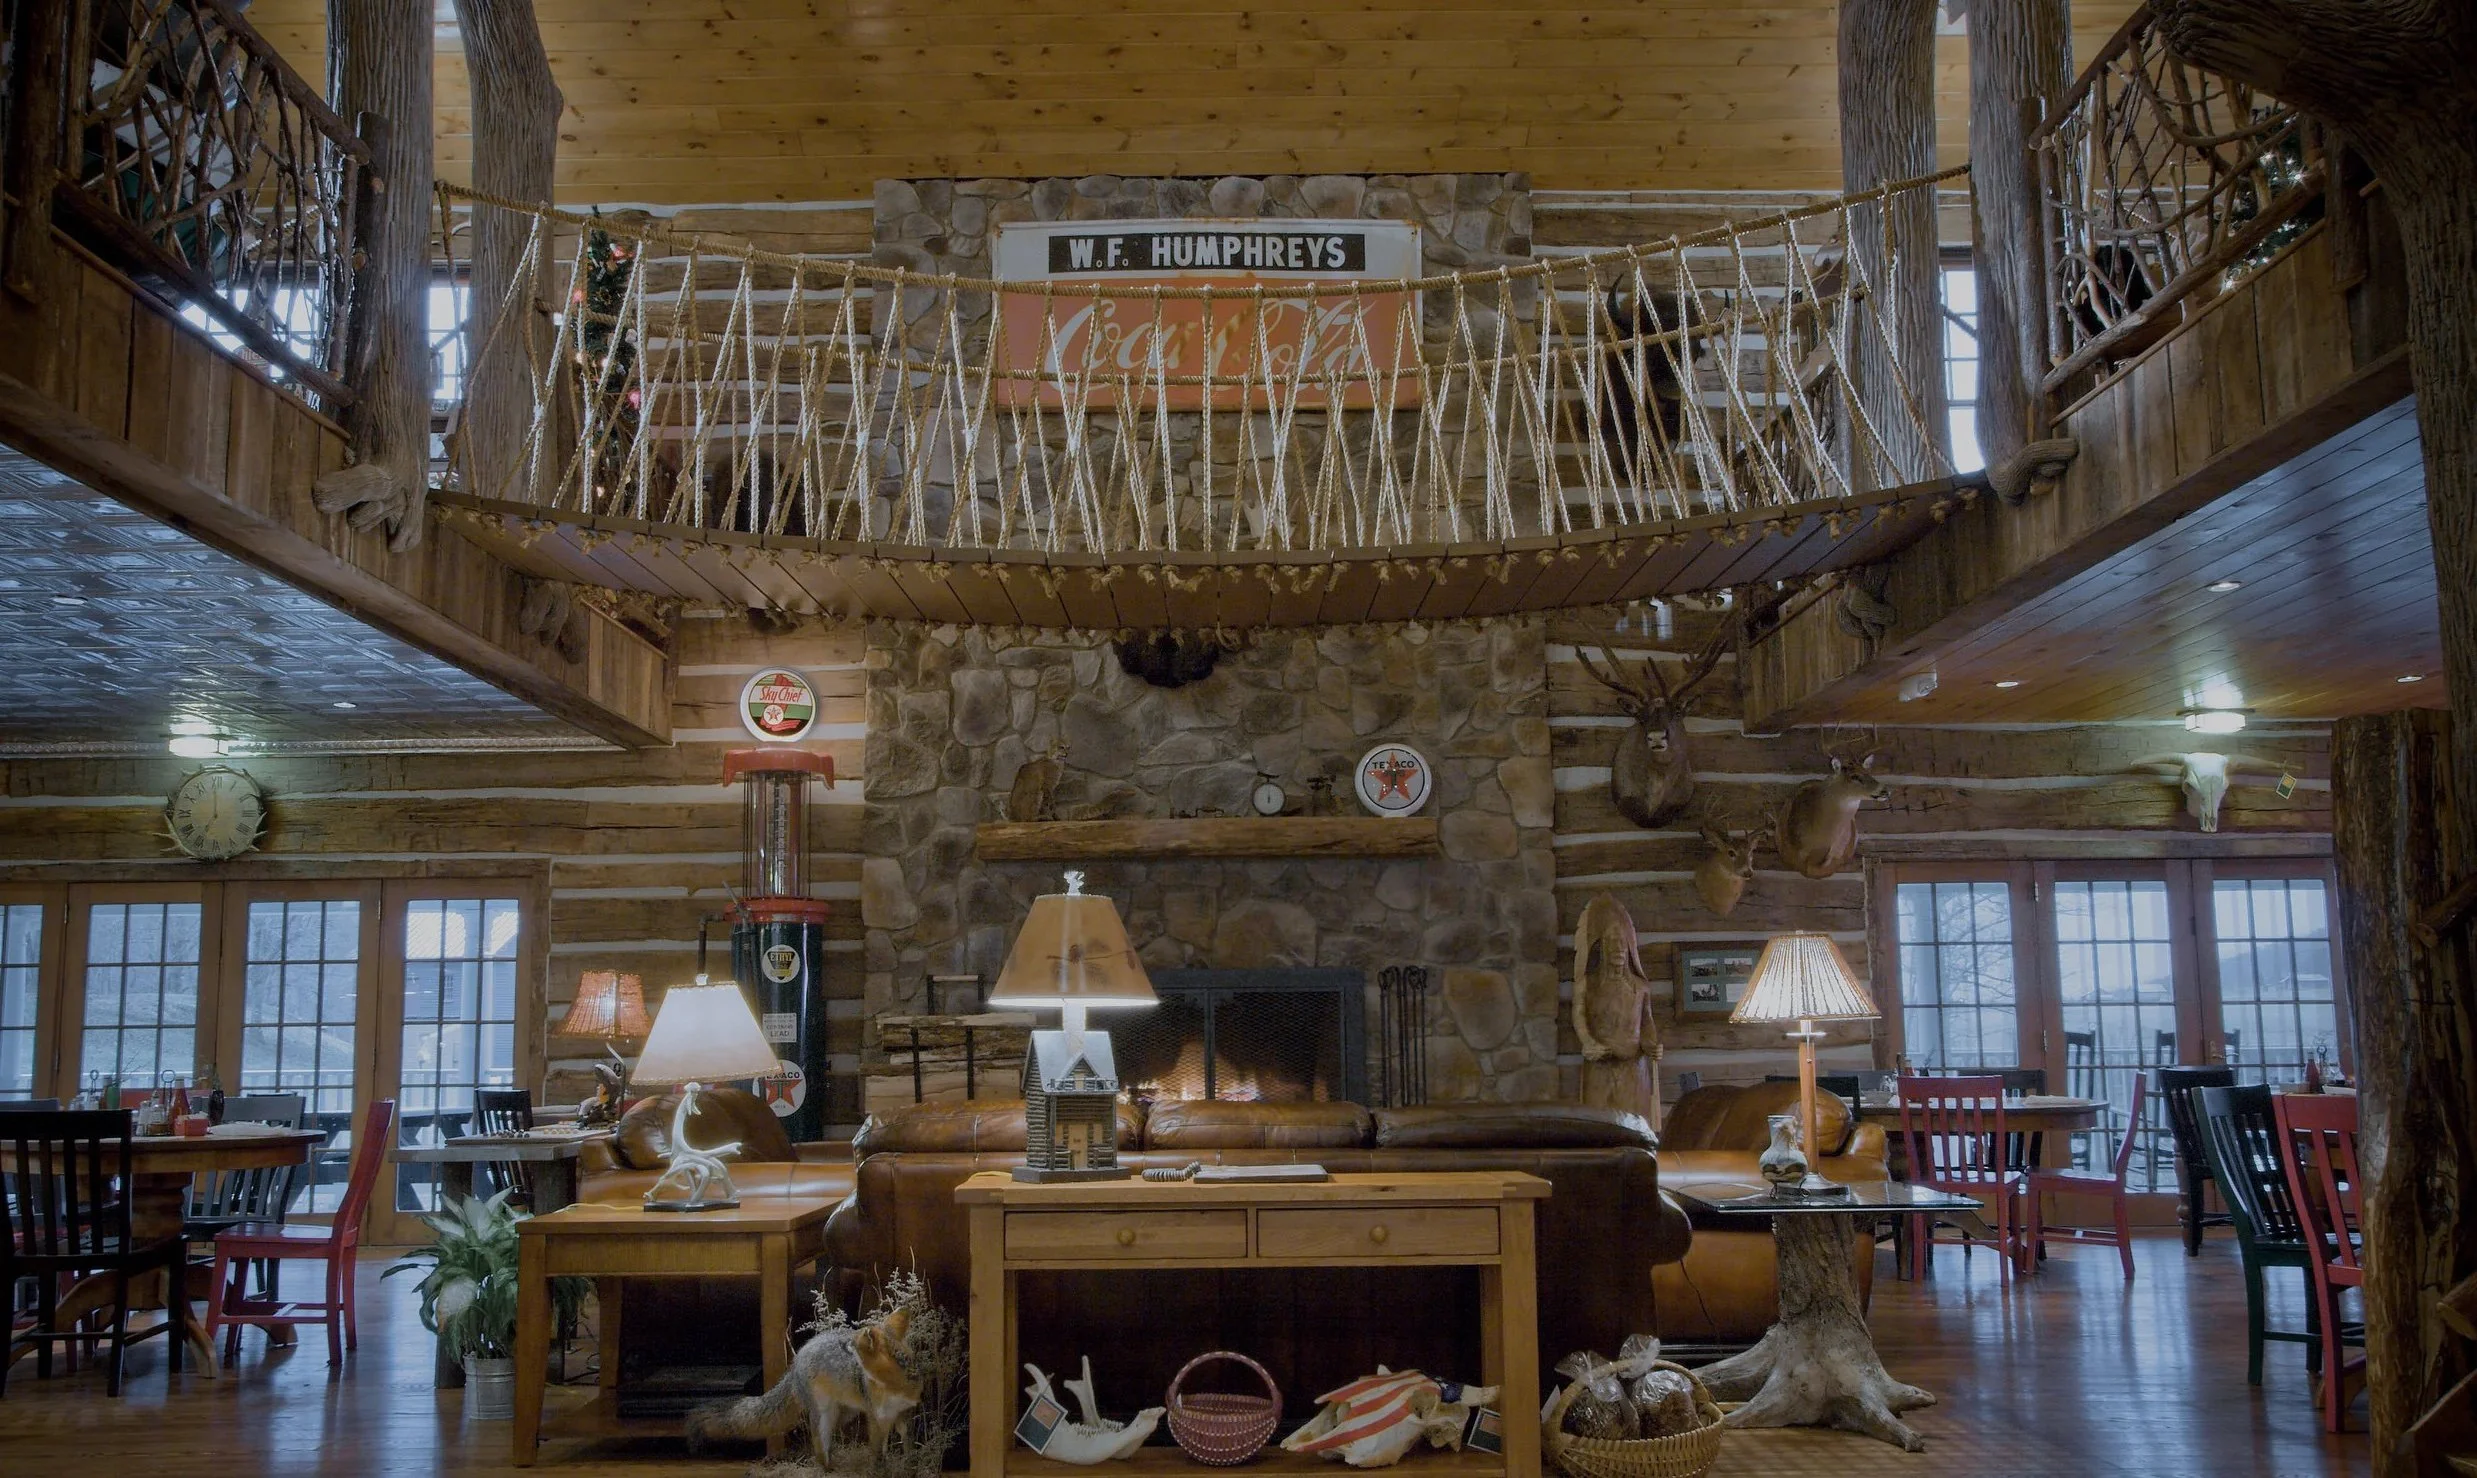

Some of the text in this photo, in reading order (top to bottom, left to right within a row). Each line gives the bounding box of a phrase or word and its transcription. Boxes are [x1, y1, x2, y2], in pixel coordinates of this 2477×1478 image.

[1150, 234, 1347, 269] HUMPHREYS
[759, 685, 803, 704] Sky Chief
[1372, 760, 1415, 769] TEXACO
[770, 952, 793, 962] ETHYL
[766, 1071, 801, 1080] XACO
